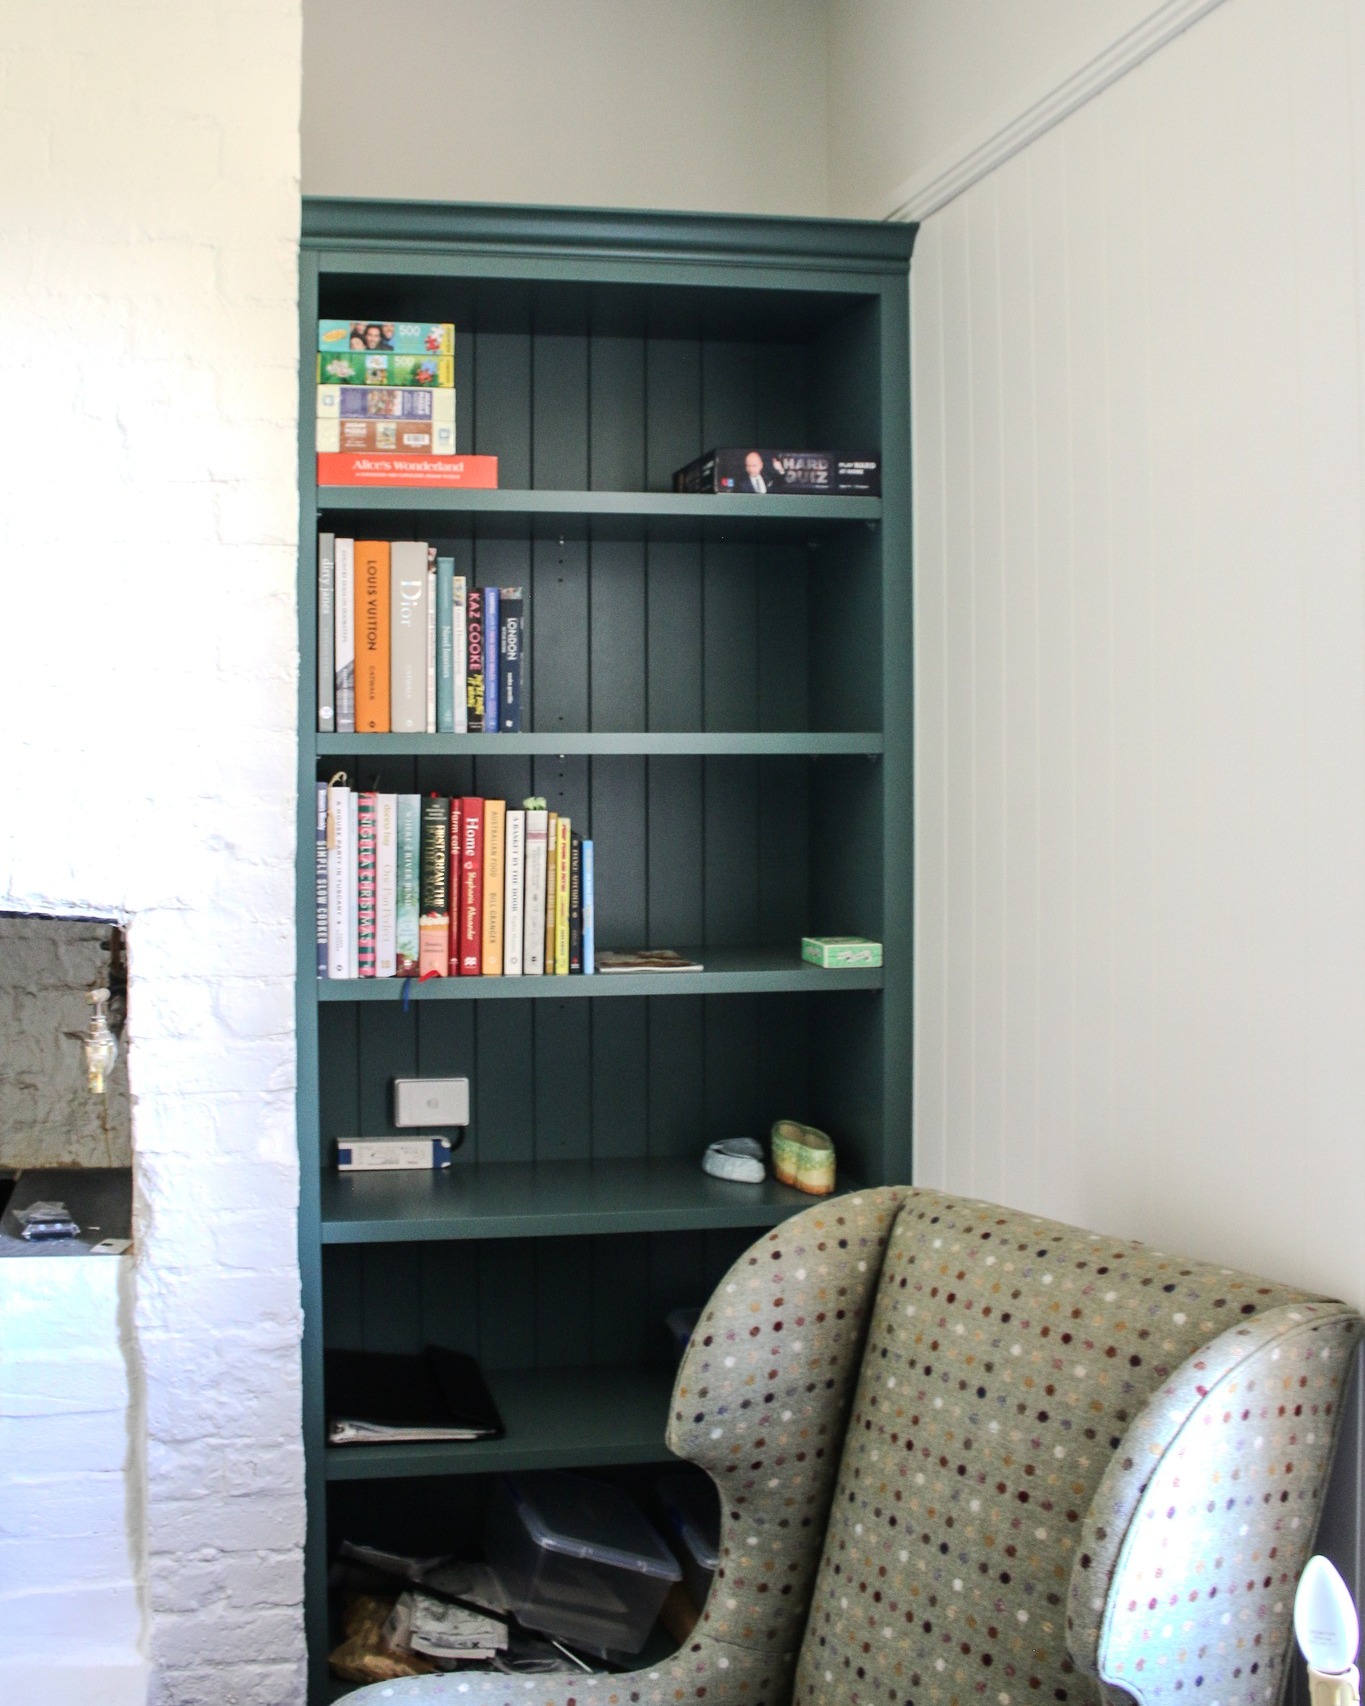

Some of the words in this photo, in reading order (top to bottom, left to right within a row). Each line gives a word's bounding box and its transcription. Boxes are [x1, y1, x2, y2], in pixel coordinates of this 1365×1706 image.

[399, 324, 421, 337] 500
[394, 355, 416, 367] 500
[353, 459, 392, 470] Alice's
[393, 460, 464, 471] Wonderland
[783, 457, 829, 470] HARD
[785, 469, 829, 484] QUIZ
[319, 558, 334, 584] dirty
[367, 559, 378, 595] LOUIS
[319, 587, 333, 615] janes
[400, 579, 422, 628] Dior
[469, 592, 481, 619] KAZ
[367, 599, 378, 652] VUITTON
[507, 617, 518, 661] LONDON
[469, 622, 482, 671] COOKE
[368, 665, 376, 701] CATWALK
[384, 804, 392, 829] donna
[451, 810, 461, 834] farm
[360, 812, 373, 867] NIGELLA
[465, 817, 479, 857] Home
[490, 811, 498, 855] AUSTRALIAN
[317, 840, 328, 874] SIMPLE
[404, 852, 413, 881] RIVER
[490, 857, 498, 878] FOOD
[512, 856, 519, 867] BY
[336, 867, 343, 877] IN
[317, 878, 328, 905] SLOW
[359, 871, 373, 944] CHRISTMAS
[317, 907, 328, 945] COOKER
[489, 910, 497, 944] GRANGER
